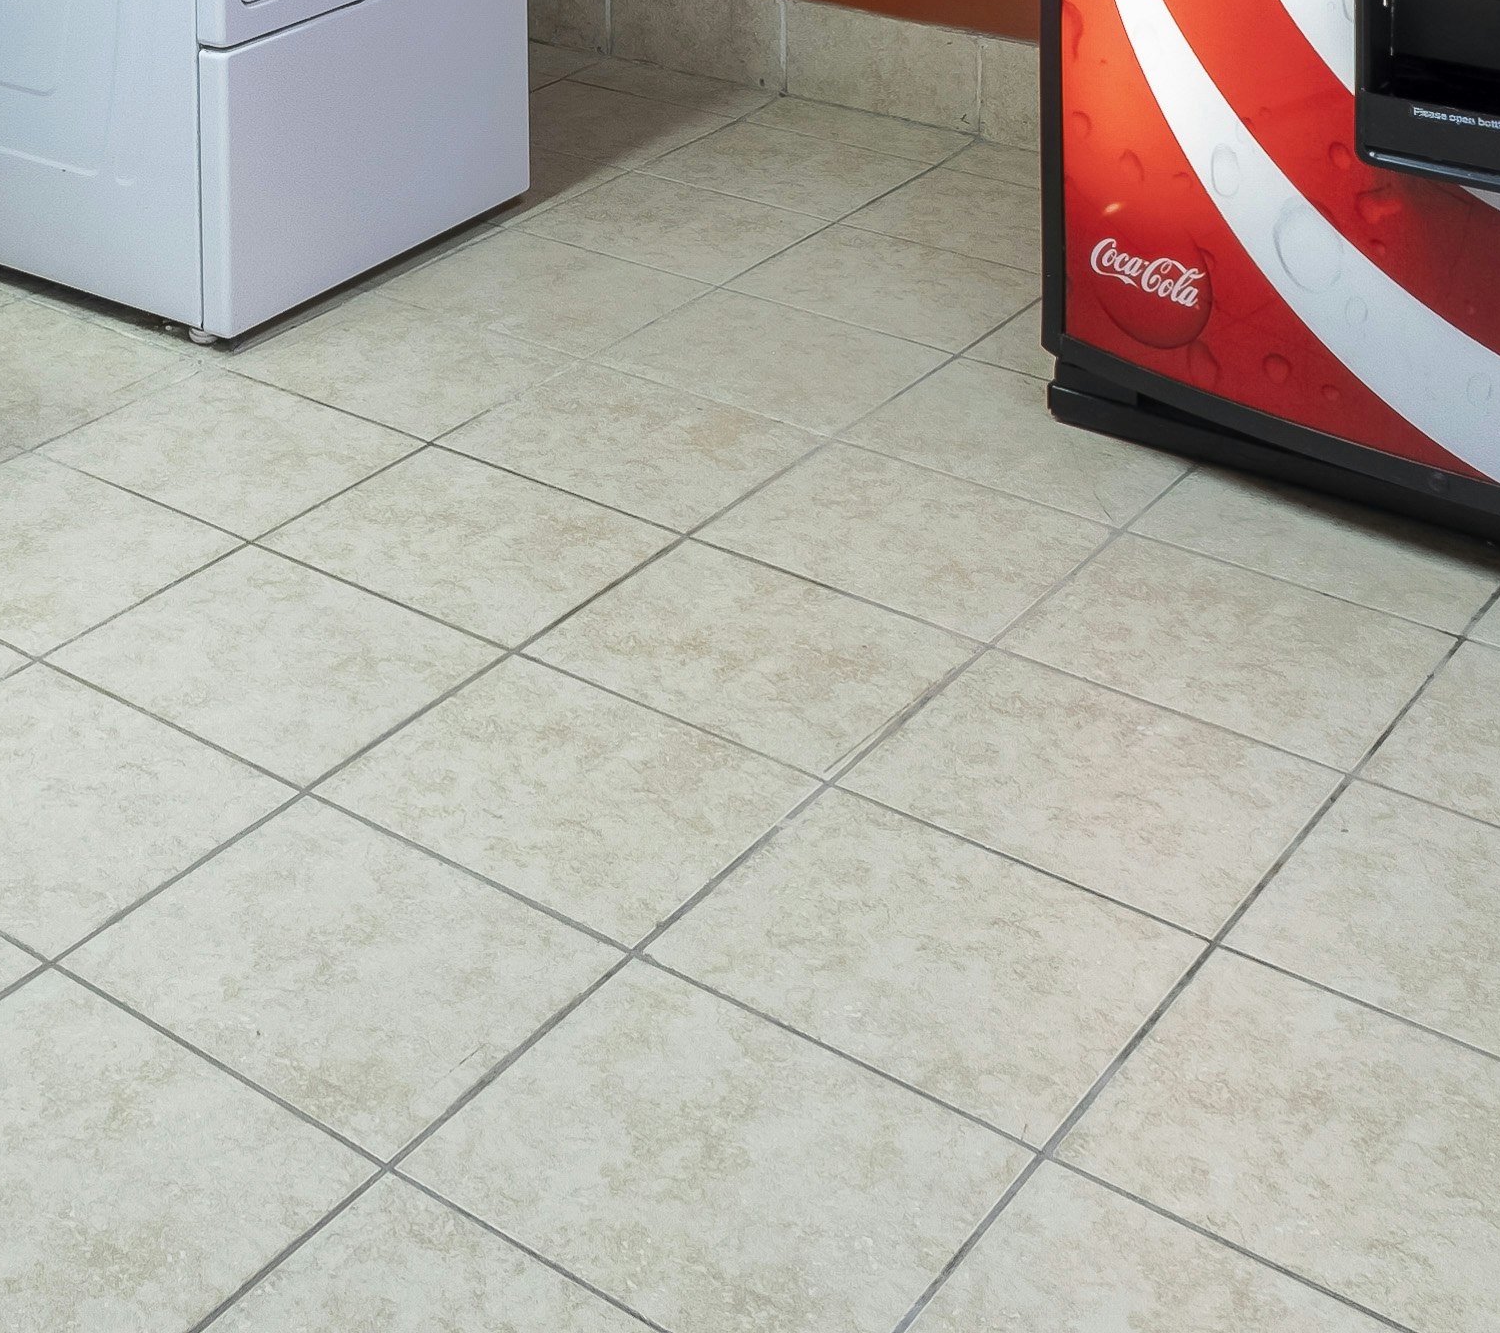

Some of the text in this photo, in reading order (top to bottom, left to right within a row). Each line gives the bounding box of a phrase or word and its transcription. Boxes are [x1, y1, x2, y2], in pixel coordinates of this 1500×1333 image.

[1413, 107, 1448, 121] Please
[1448, 113, 1476, 126] open
[1090, 237, 1206, 308] Coca-Cola
